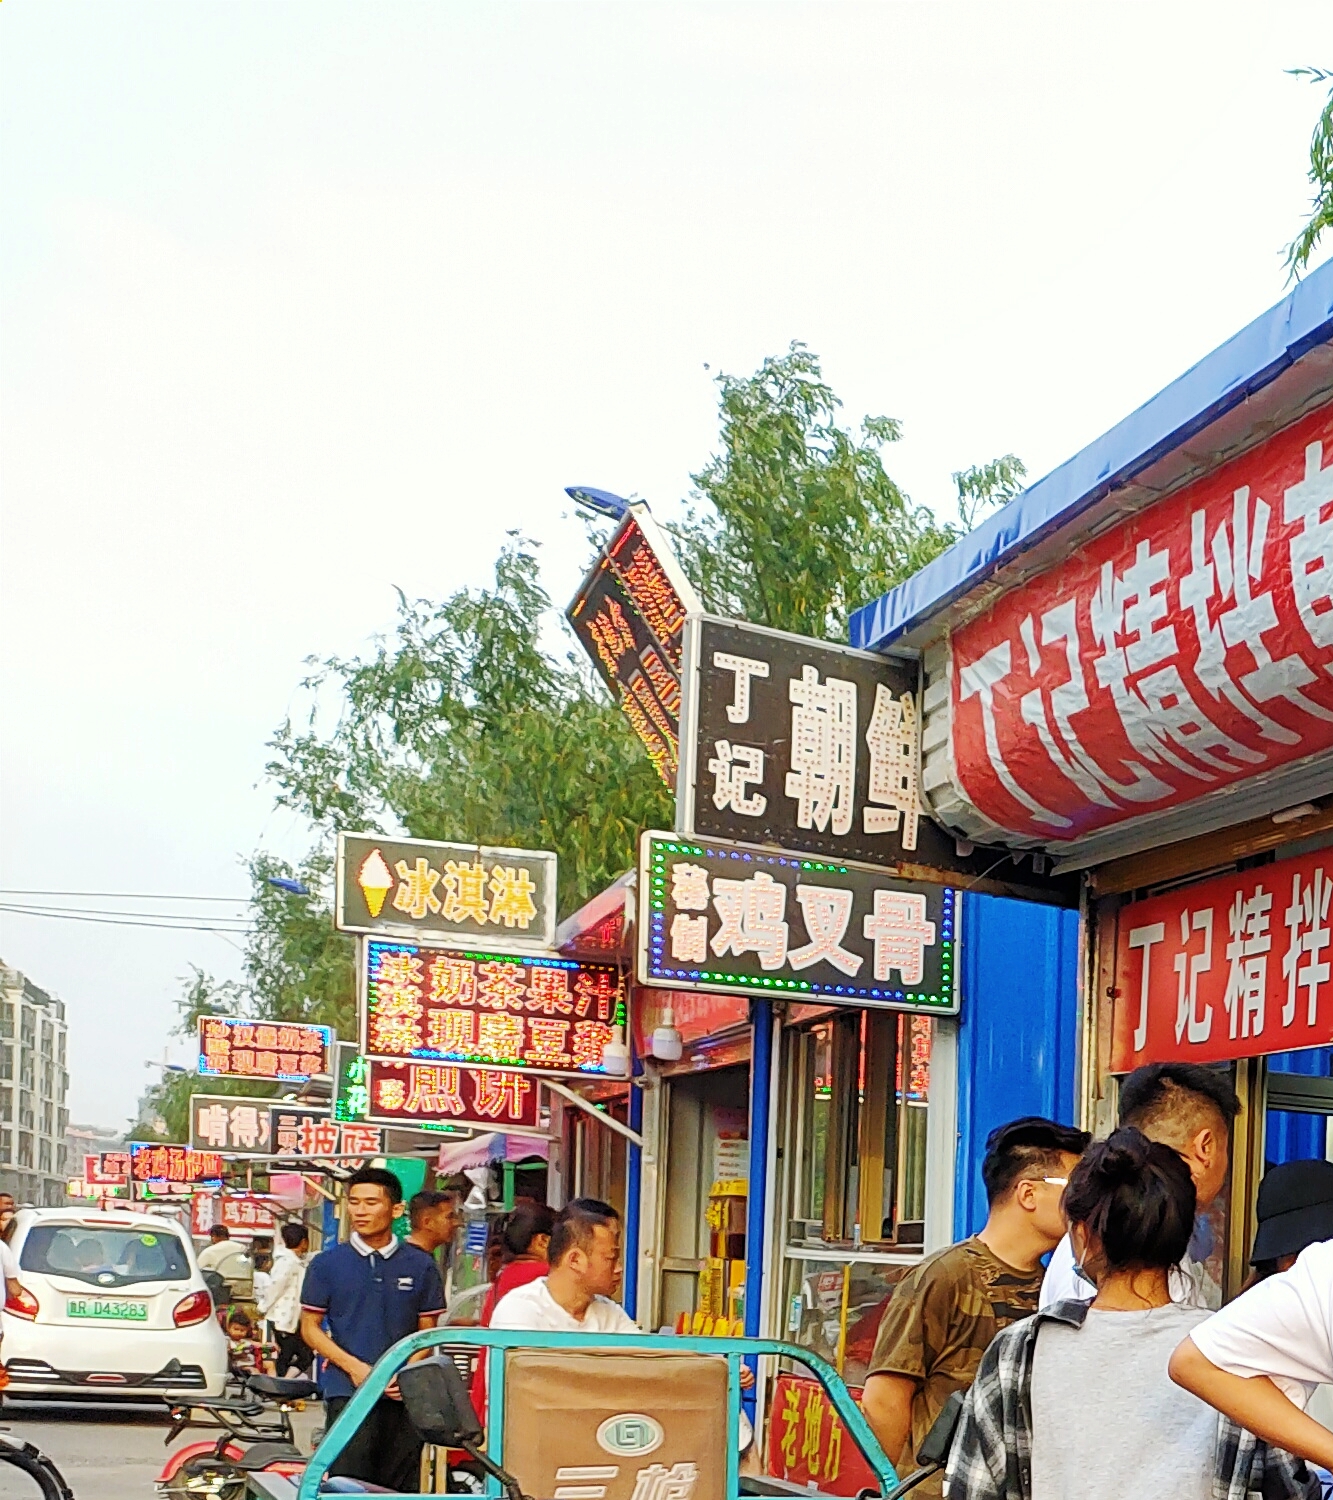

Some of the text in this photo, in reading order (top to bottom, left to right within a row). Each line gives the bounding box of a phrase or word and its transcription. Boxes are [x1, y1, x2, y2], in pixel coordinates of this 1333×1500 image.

[393, 857, 537, 929] 冰淇淋
[710, 870, 936, 986] 鸡叉骨
[428, 955, 621, 1021] 奶茶果汁
